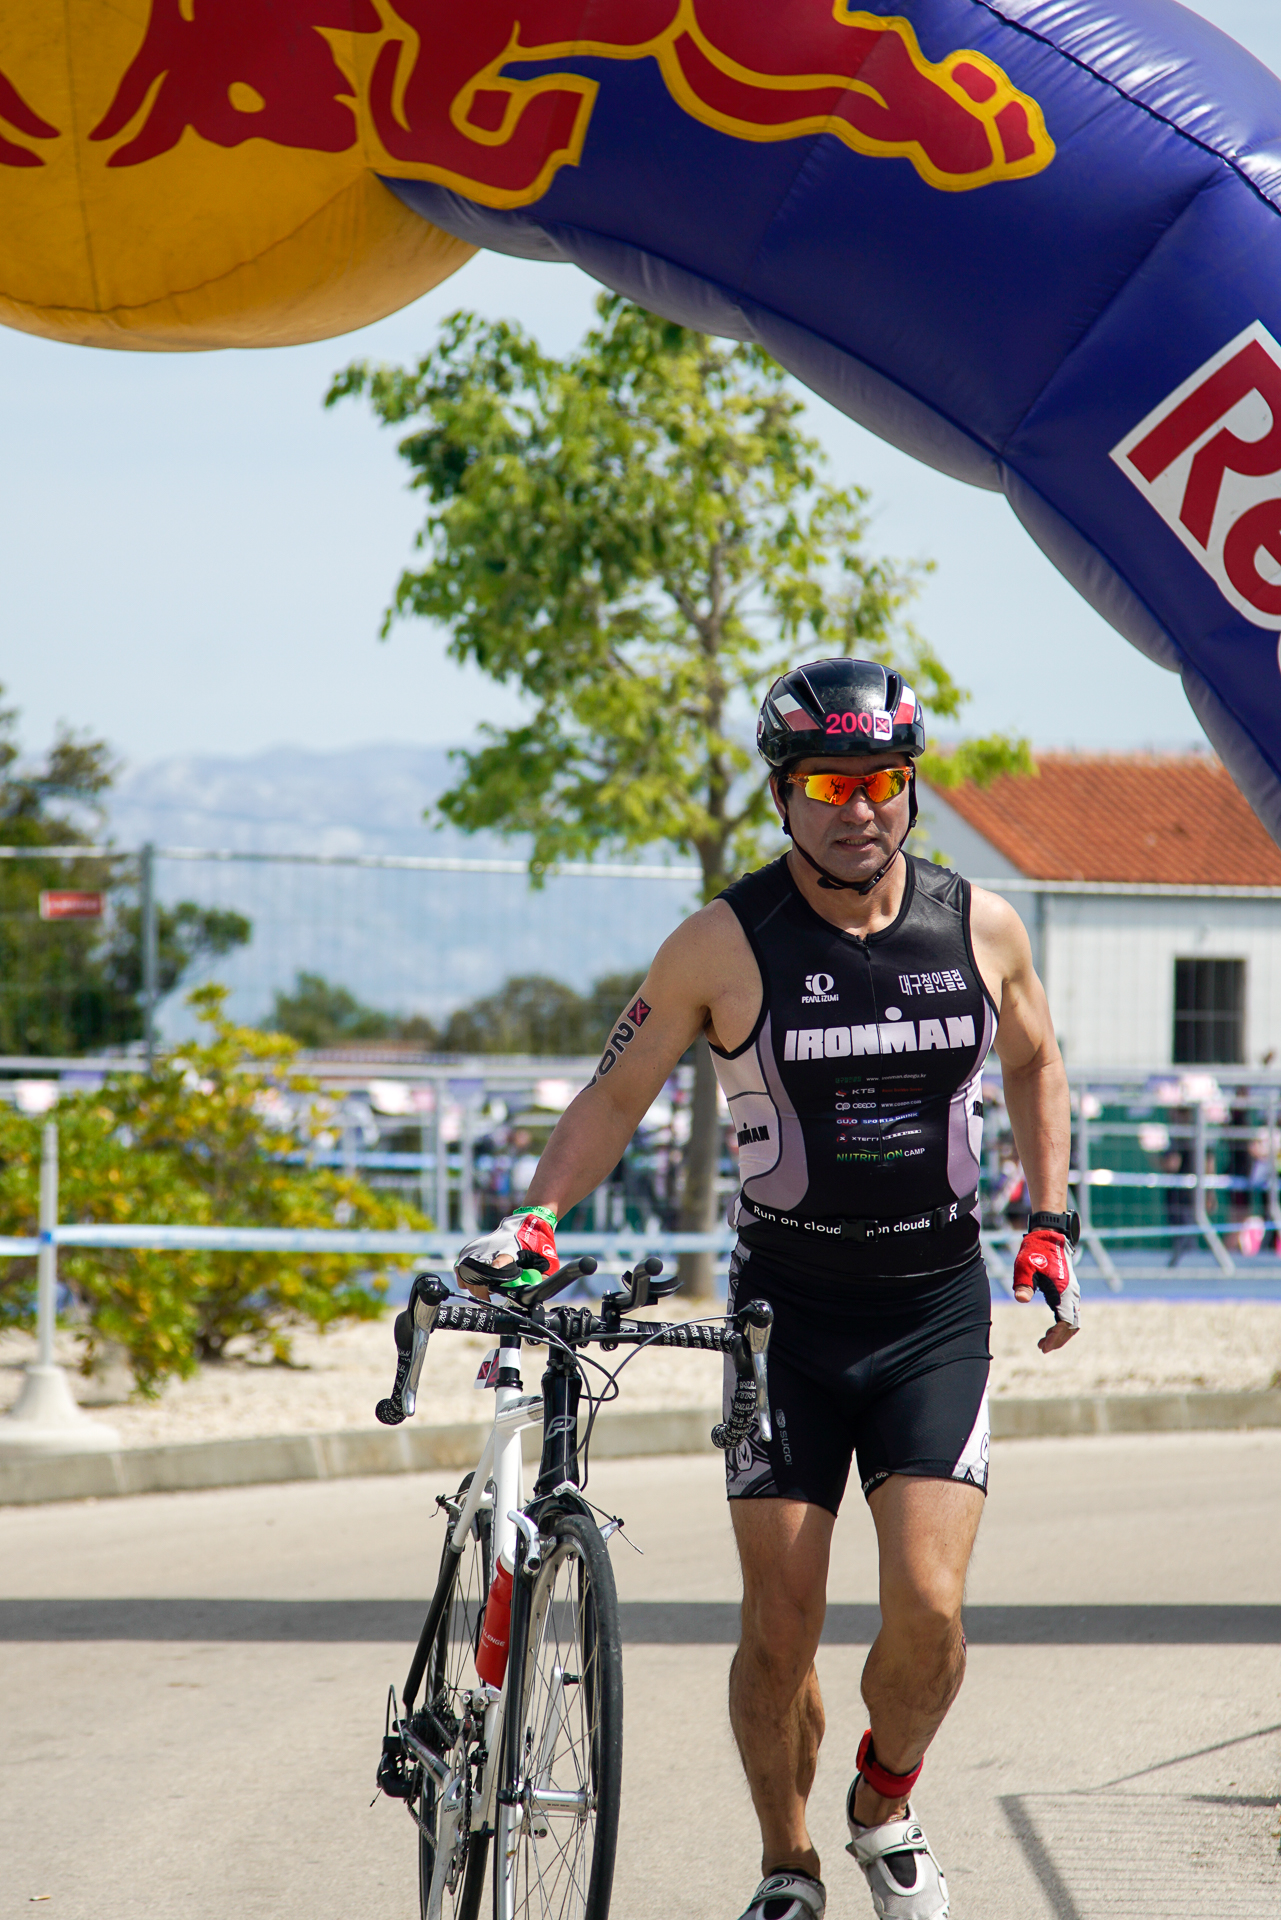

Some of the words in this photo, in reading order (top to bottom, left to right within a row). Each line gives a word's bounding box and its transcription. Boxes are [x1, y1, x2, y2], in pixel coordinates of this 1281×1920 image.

[825, 711, 873, 735] 200
[898, 968, 968, 996] 대구철인클럽
[783, 1007, 976, 1061] IRONMAN
[836, 1148, 903, 1162] NUTRITION
[904, 1147, 926, 1157] CAMP
[753, 1205, 777, 1222] Run
[780, 1216, 799, 1228] on
[893, 1217, 931, 1233] clouds
